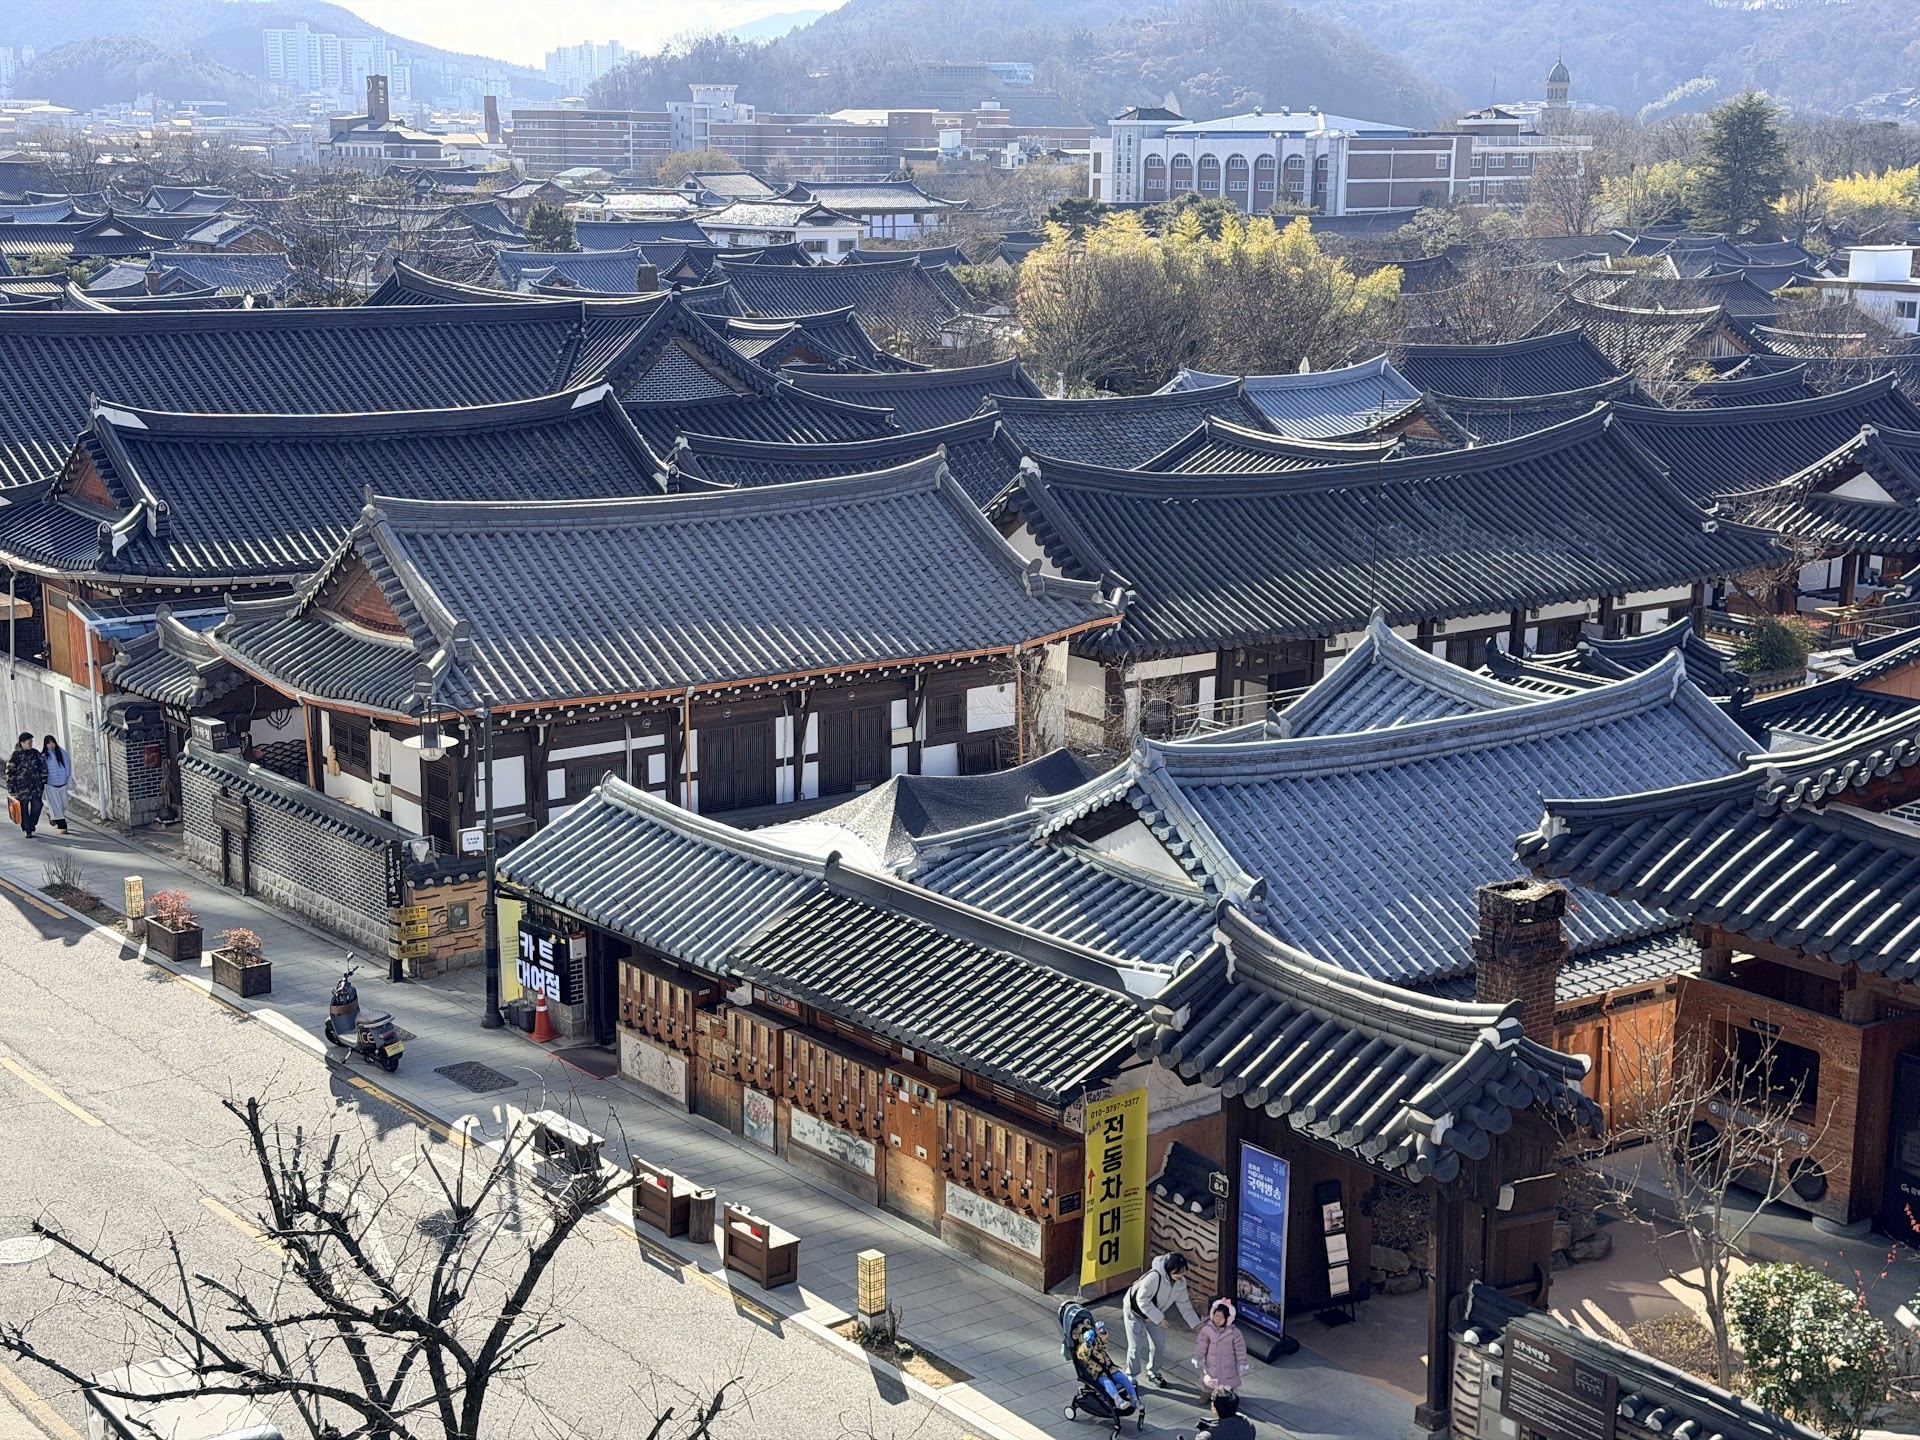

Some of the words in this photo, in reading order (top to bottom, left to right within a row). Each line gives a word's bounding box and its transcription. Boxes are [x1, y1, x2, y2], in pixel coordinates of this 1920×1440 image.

[516, 958, 560, 1002] 대여점
[1091, 1096, 1140, 1119] 010-3797-3377
[1100, 1113, 1124, 1203] 전동차
[1247, 1175, 1282, 1201] 국악방송
[1098, 1206, 1121, 1266] 대여
[1513, 1339, 1551, 1363] 전주국악방송
